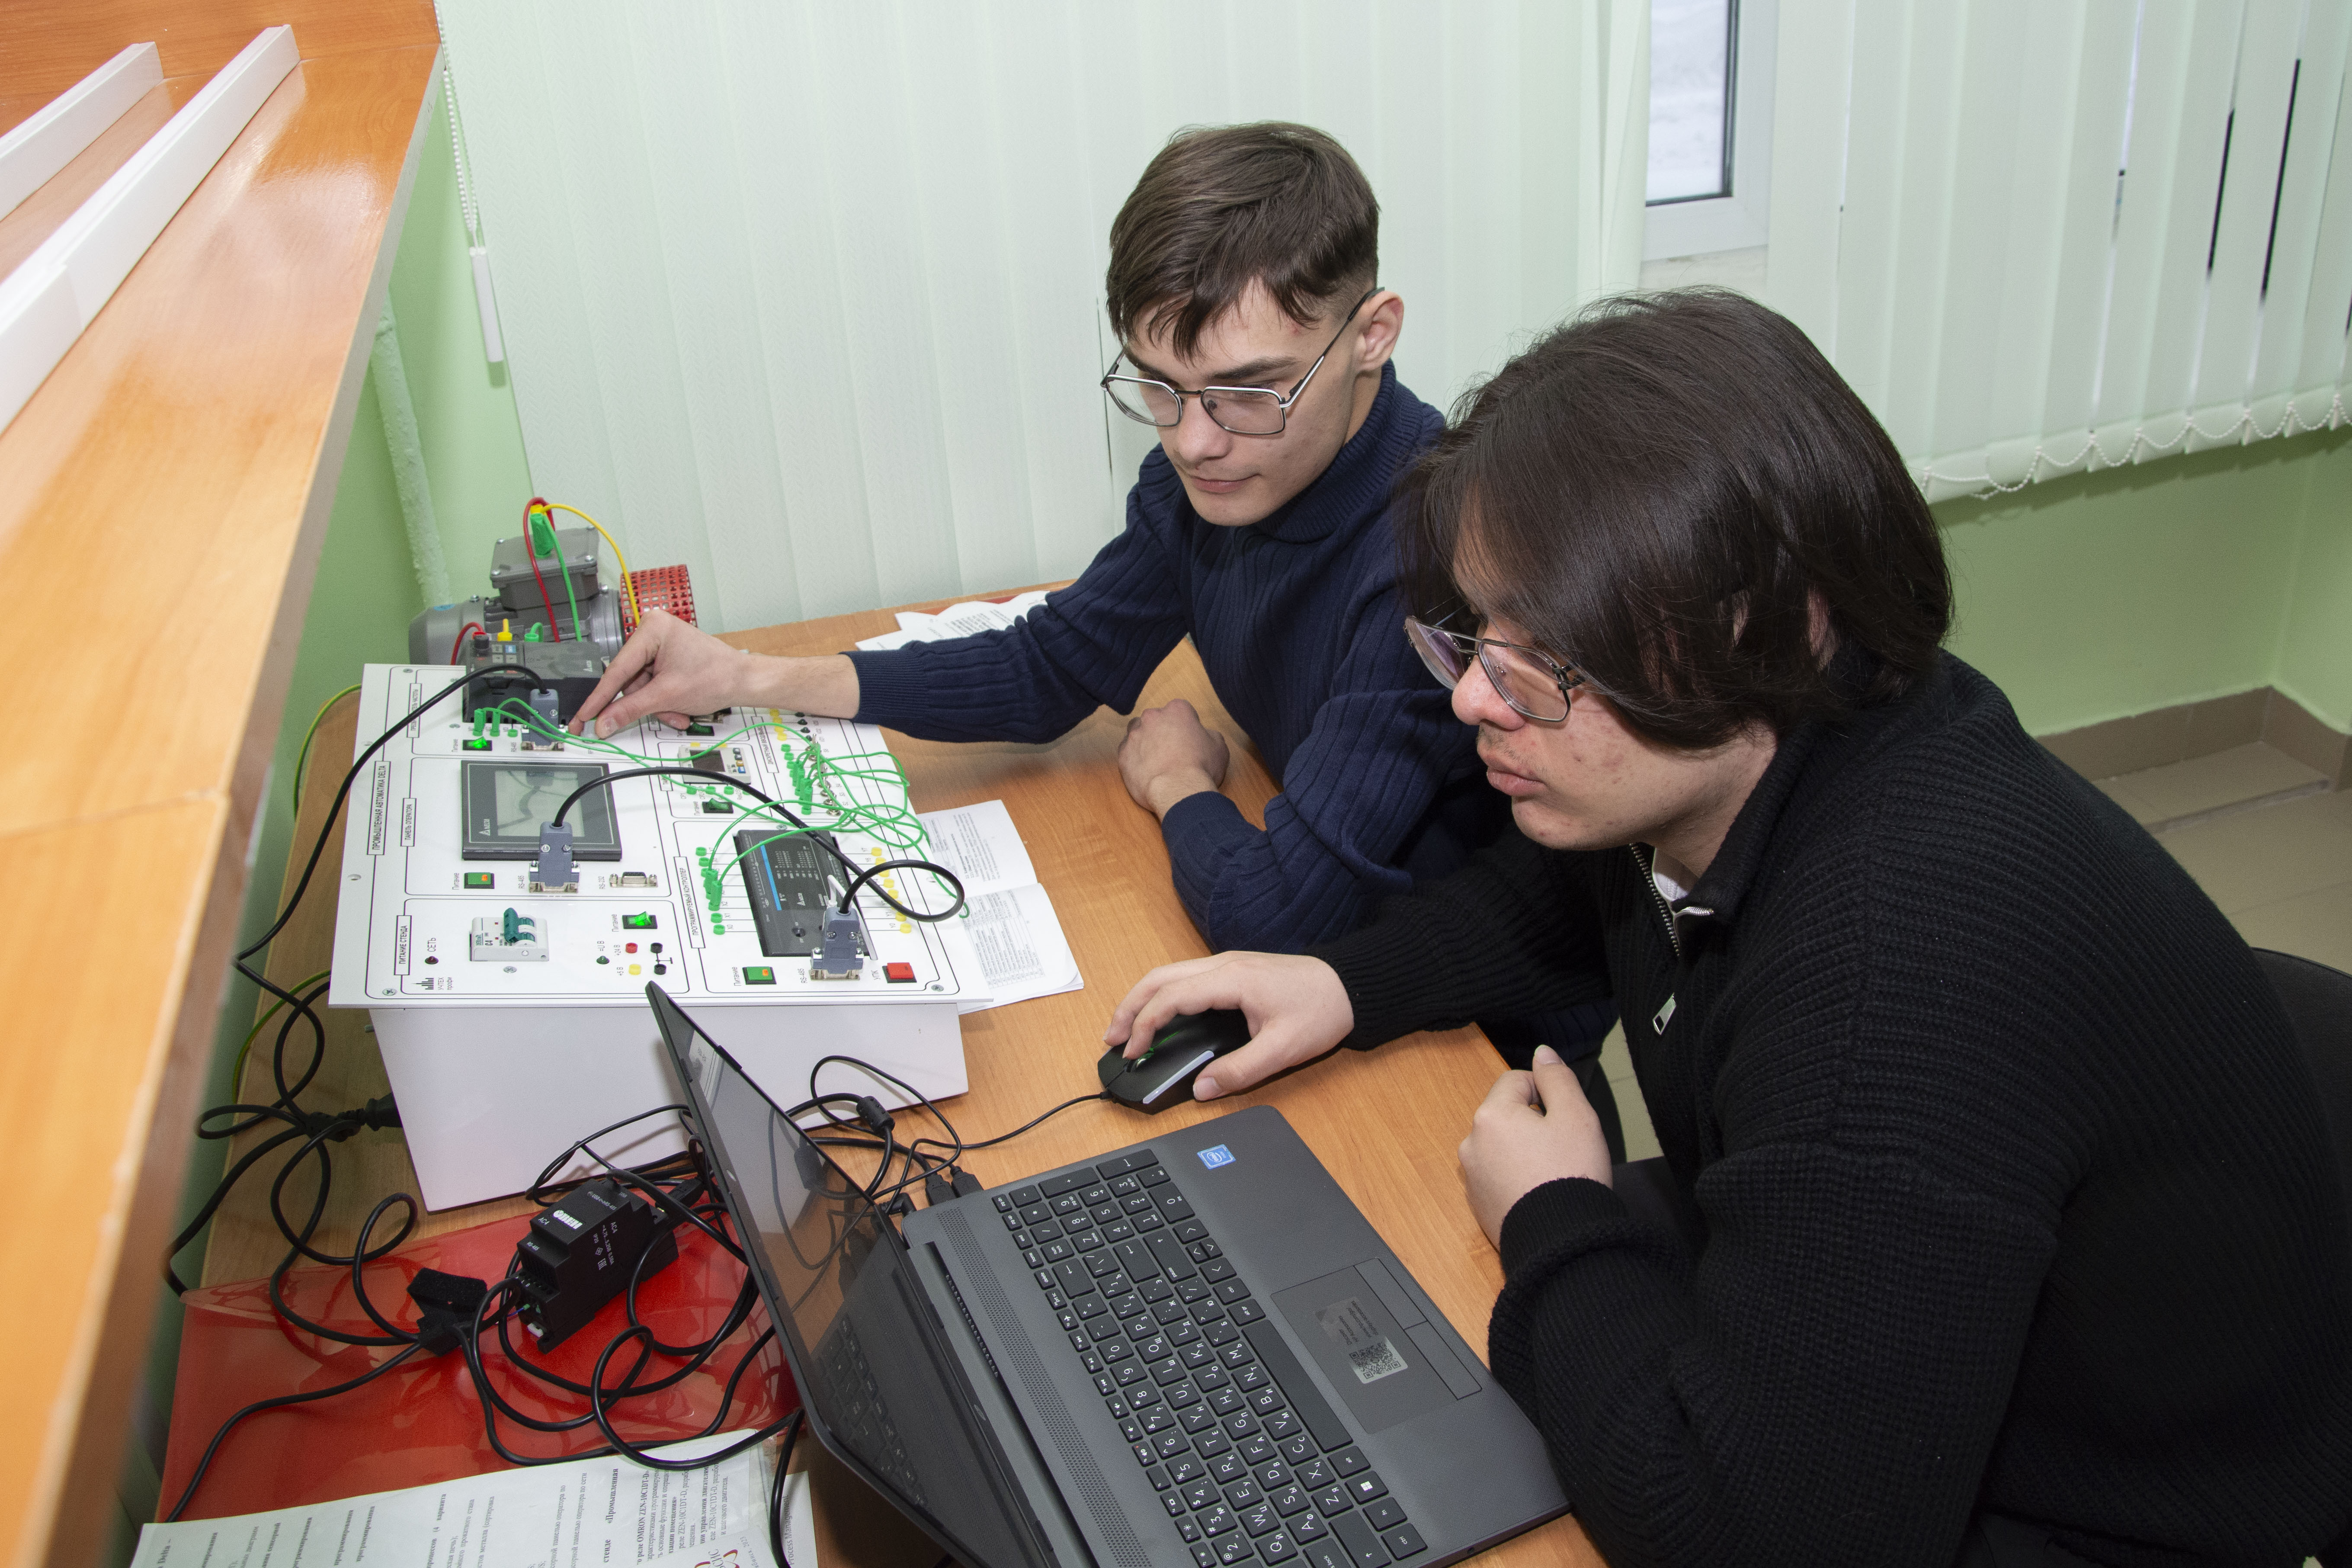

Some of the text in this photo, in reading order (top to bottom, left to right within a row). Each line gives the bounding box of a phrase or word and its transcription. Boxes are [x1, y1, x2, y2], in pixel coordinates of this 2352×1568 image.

[761, 744, 773, 764] ДИСКРЕТНЫЙ
[372, 766, 386, 850] ПРОМЫШЛЕННАЯ АВТОМАТИКА DELTA
[680, 868, 699, 935] ПРОГРАММИРУЕМЫЙ КОНТРОЛЛЕР
[399, 926, 408, 964] ПИТАНИЕ СТЕНДА
[428, 938, 436, 952] СЕТЬ
[798, 968, 808, 983] RS-485
[871, 970, 881, 980] УПК
[1191, 1350, 1202, 1358] K
[1229, 1350, 1241, 1359] M
[1244, 1372, 1256, 1381] N
[1220, 1395, 1231, 1404] H
[1293, 1444, 1304, 1453] C
[1222, 1463, 1233, 1472] R
[1268, 1470, 1279, 1479] D
[1309, 1469, 1321, 1478] X
[1237, 1489, 1249, 1497] E
[1326, 1495, 1339, 1505] Z
[436, 1494, 446, 1520] варианта
[555, 1494, 566, 1520] оператора
[576, 1494, 586, 1519] оператора
[603, 1469, 619, 1563] стенде «Промышленная
[659, 1499, 668, 1523] функции
[670, 1497, 678, 1533] помещения»
[460, 1517, 471, 1547] прокатного
[478, 1496, 495, 1552] металла (сортировка
[637, 1517, 645, 1542] OMRON
[781, 1495, 794, 1565] Process Management
[1252, 1514, 1266, 1526] W
[245, 1526, 259, 1552] диаграмм
[266, 1523, 281, 1552] сенсорной
[293, 1517, 312, 1568] рограммирования
[335, 1510, 354, 1565] программирования
[355, 1506, 375, 1562] программирования
[449, 1536, 458, 1553] печь);
[552, 1521, 561, 1546] панелью
[647, 1512, 657, 1561] арактеристиками
[658, 1524, 666, 1551] основные
[740, 1536, 750, 1547] 2023
[157, 1546, 171, 1564] Delta
[1270, 1541, 1282, 1552] Q
